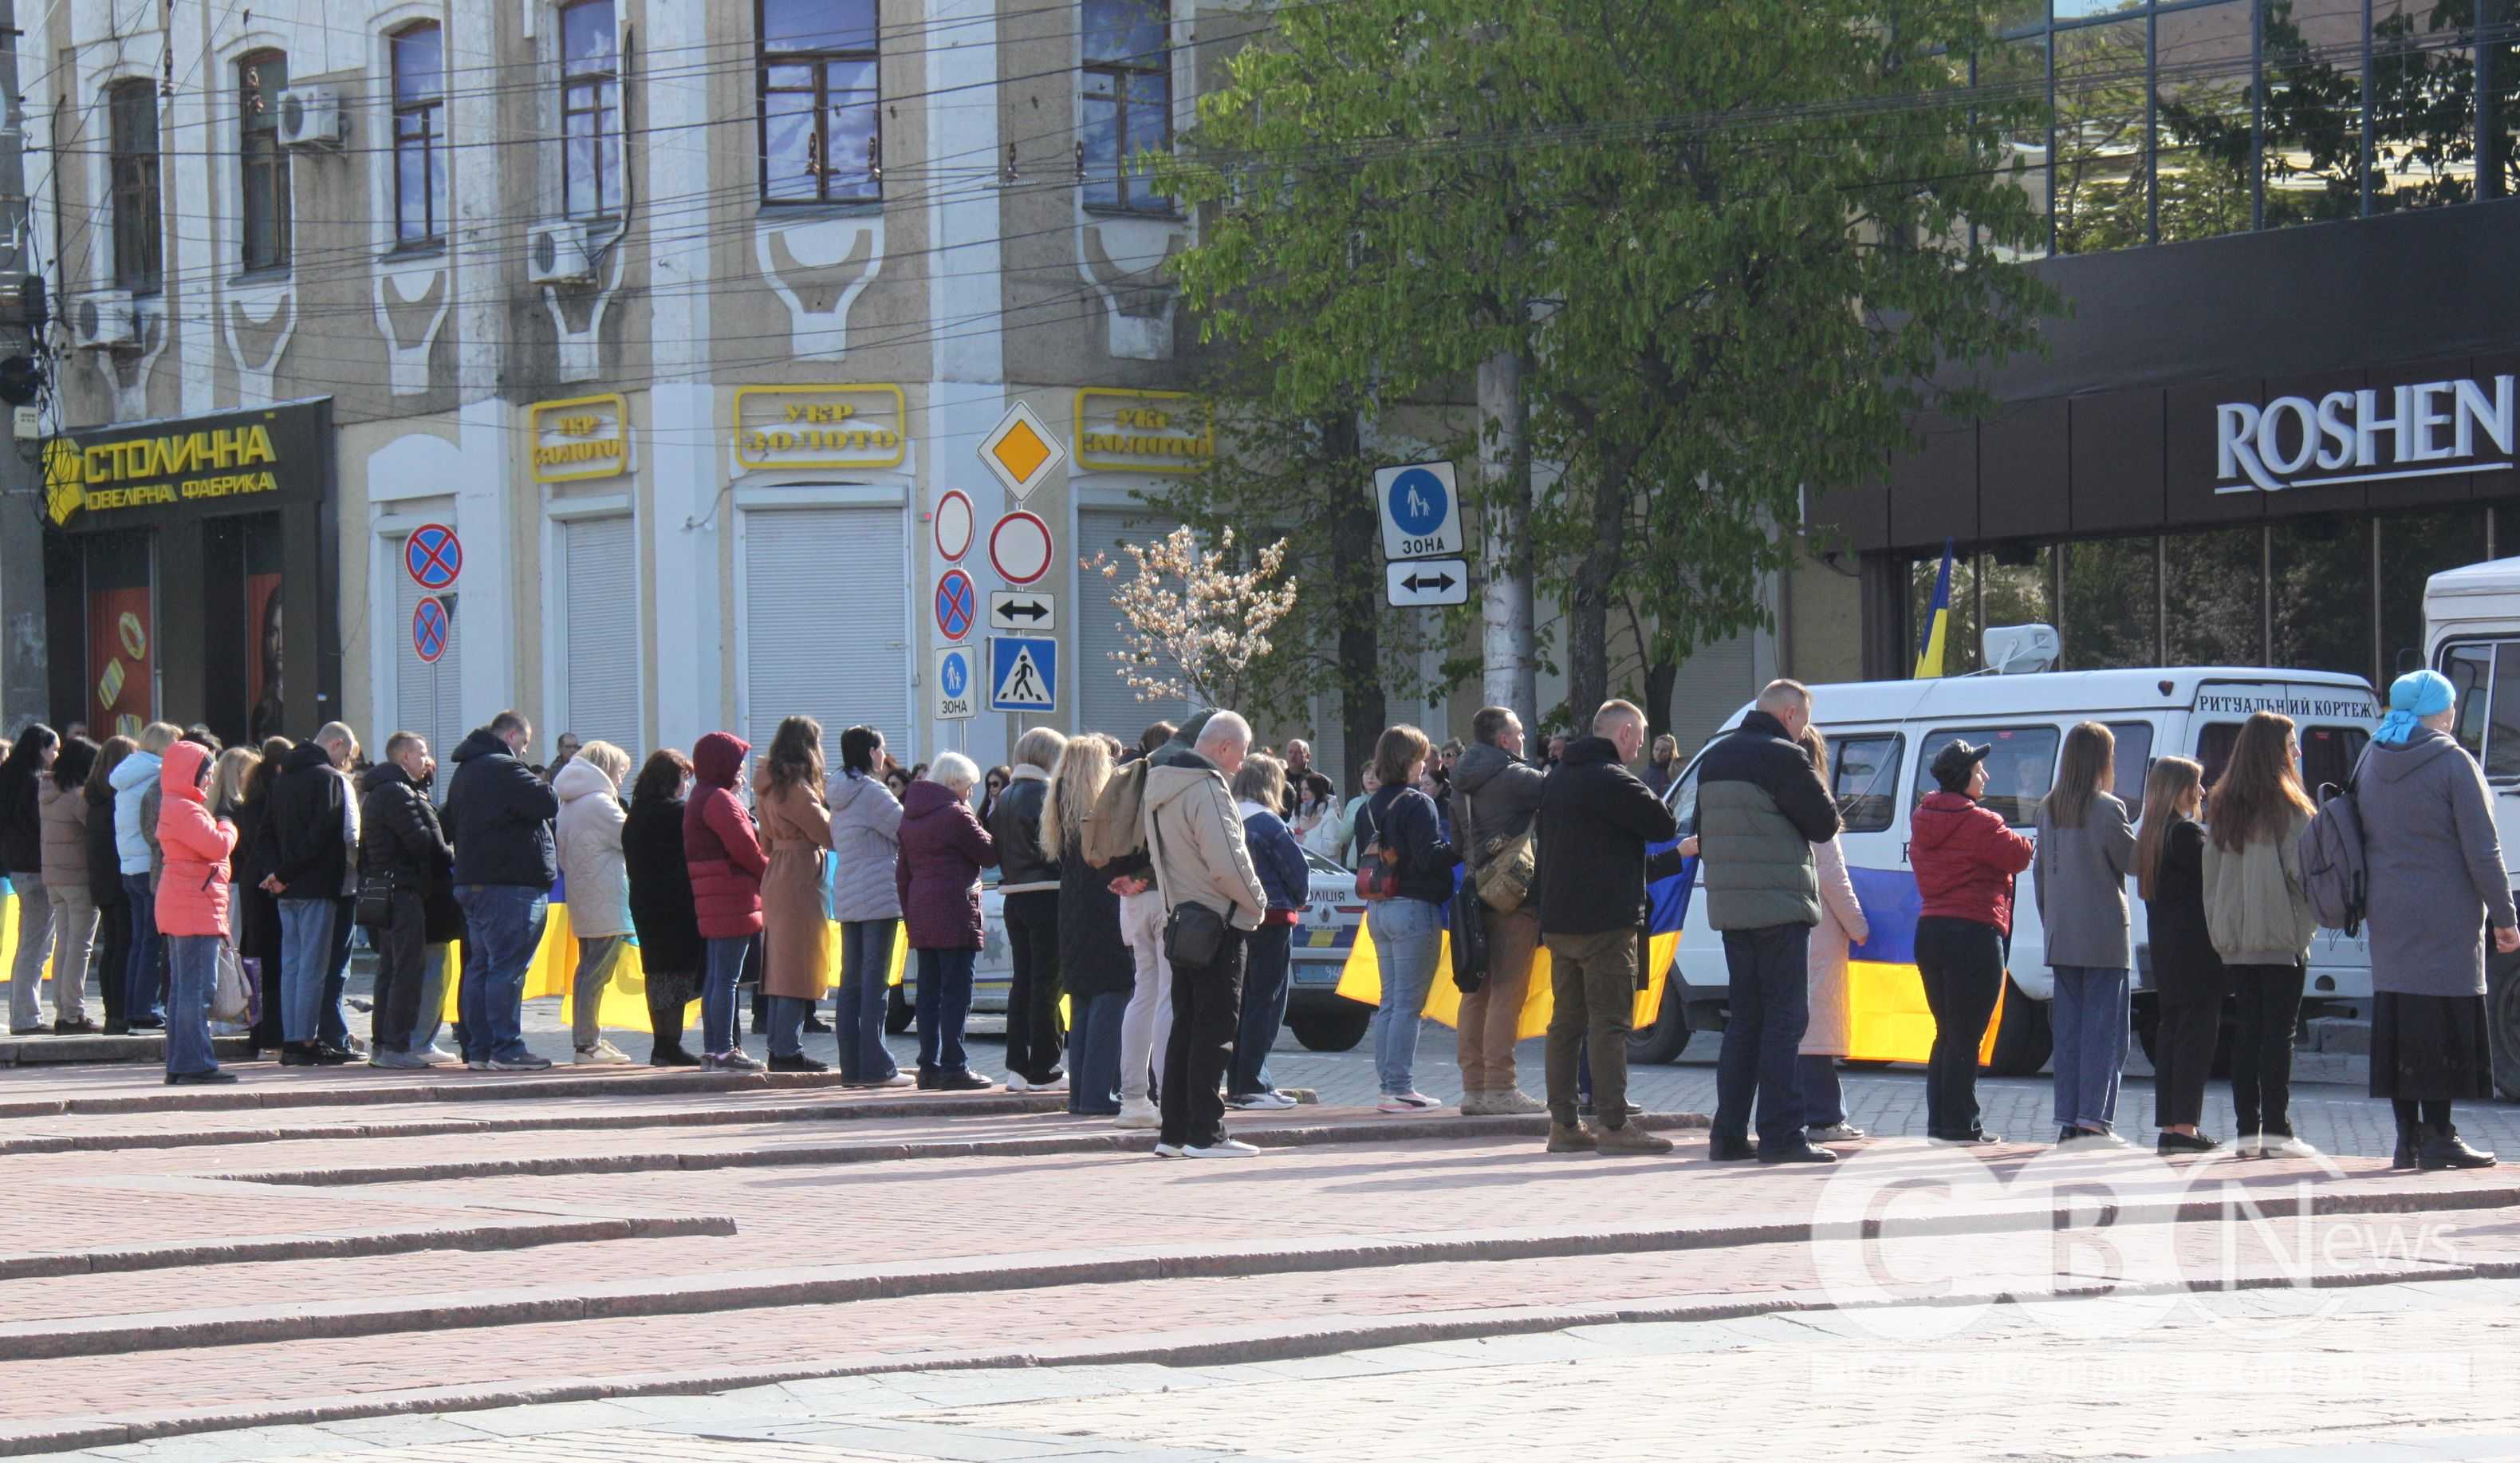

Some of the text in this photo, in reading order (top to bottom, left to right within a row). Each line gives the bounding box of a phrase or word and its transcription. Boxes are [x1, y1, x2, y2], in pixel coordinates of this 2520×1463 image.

[783, 403, 856, 424] УКР
[743, 429, 899, 452] ЗОЛОТО
[2215, 374, 2514, 492] ROSHEN
[85, 424, 277, 483] СТОЛИЧНА
[85, 471, 278, 511] ЮВЕЛІРНА ФАБРИКА
[1402, 537, 1445, 554] ЗОНА
[942, 700, 967, 715] ЗОНА
[2199, 695, 2372, 718] РИТУАЛЬНИЙ КОРТЕЖ
[1308, 890, 1345, 902] ОЛІЦІЯ
